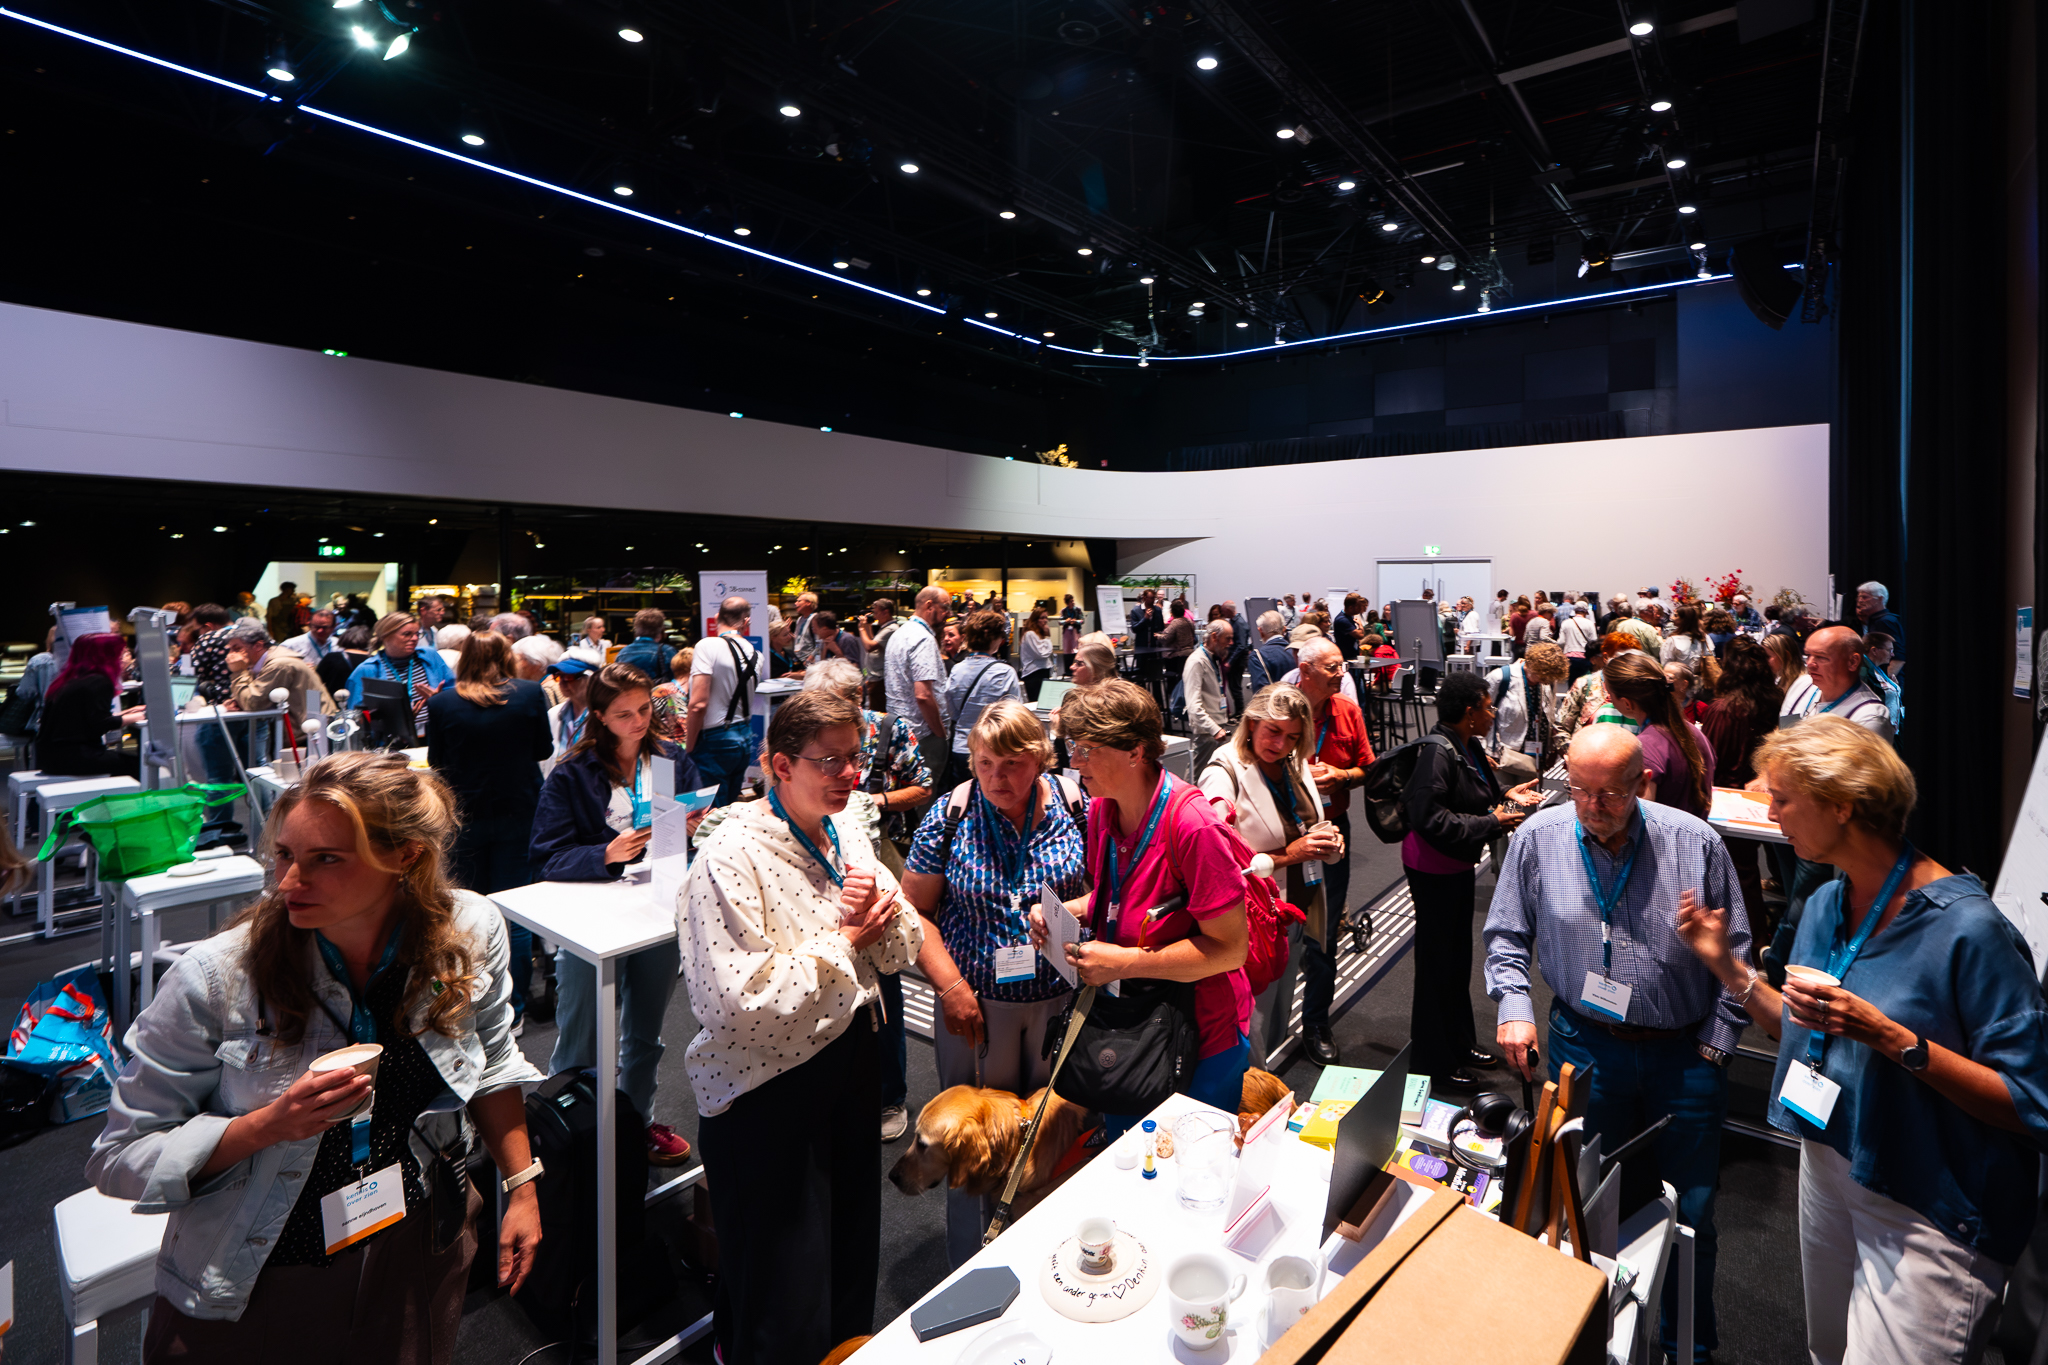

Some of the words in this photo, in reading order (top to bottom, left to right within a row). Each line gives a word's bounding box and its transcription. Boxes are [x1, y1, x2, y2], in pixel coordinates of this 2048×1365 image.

[346, 1187, 369, 1200] kennis
[346, 1196, 362, 1207] over
[1063, 1286, 1086, 1298] ander
